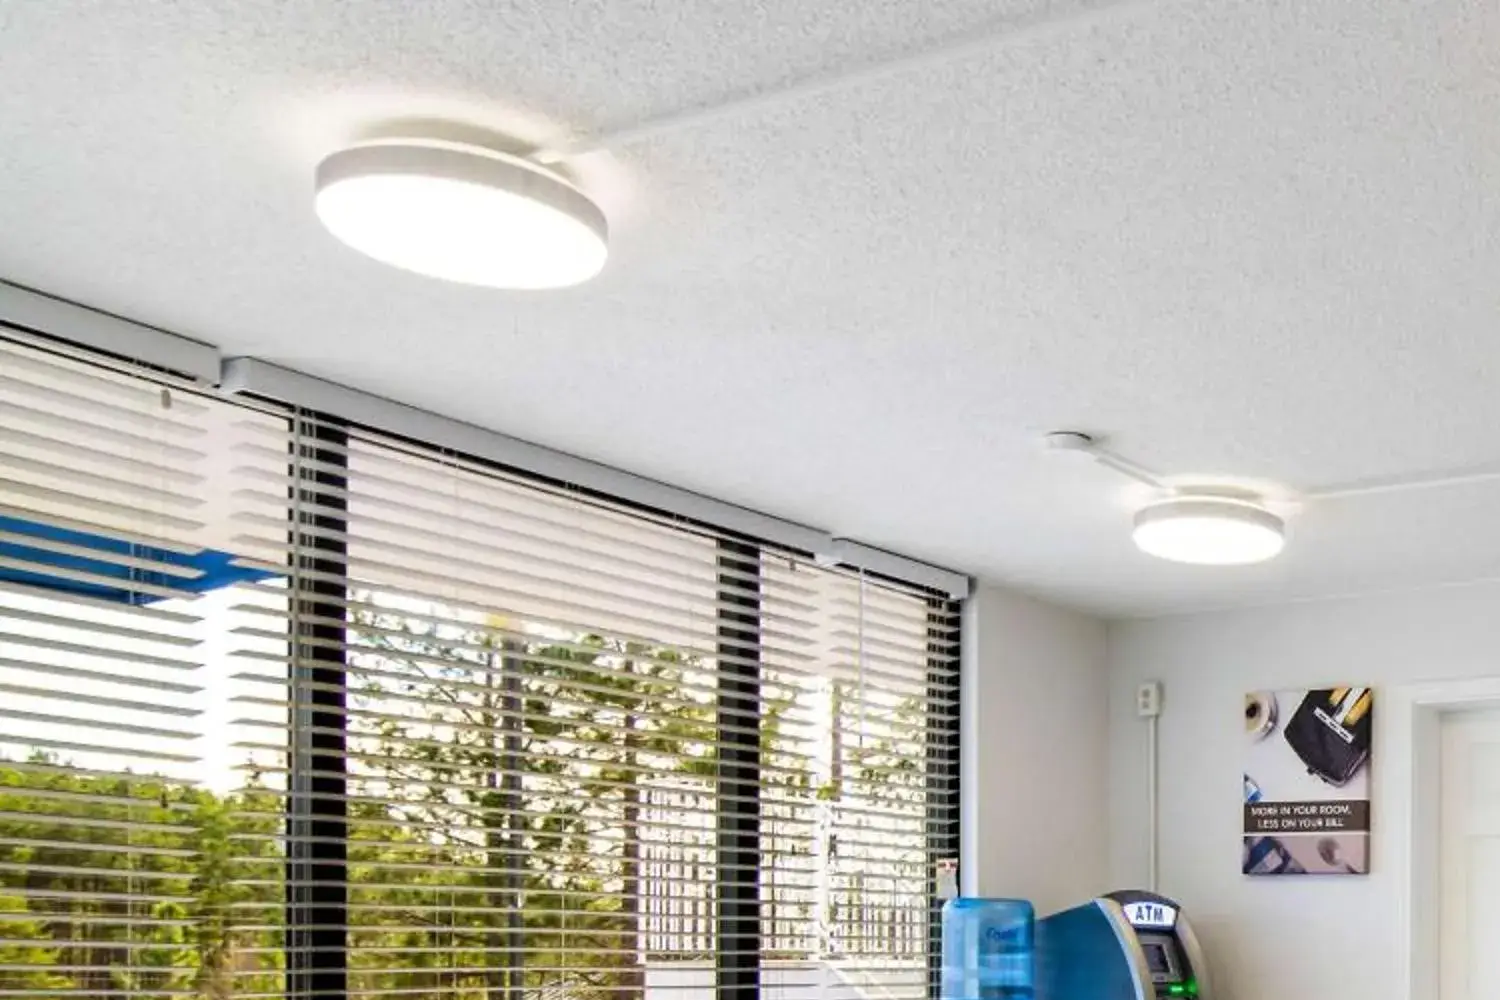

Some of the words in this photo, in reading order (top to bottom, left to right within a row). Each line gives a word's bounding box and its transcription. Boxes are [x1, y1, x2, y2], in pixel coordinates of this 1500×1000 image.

[1280, 805, 1291, 815] IN
[1293, 805, 1318, 816] YOUR
[1257, 819, 1279, 829] LESS
[1281, 818, 1297, 829] ON
[1299, 817, 1323, 828] YOUR
[1135, 905, 1163, 921] ATM
